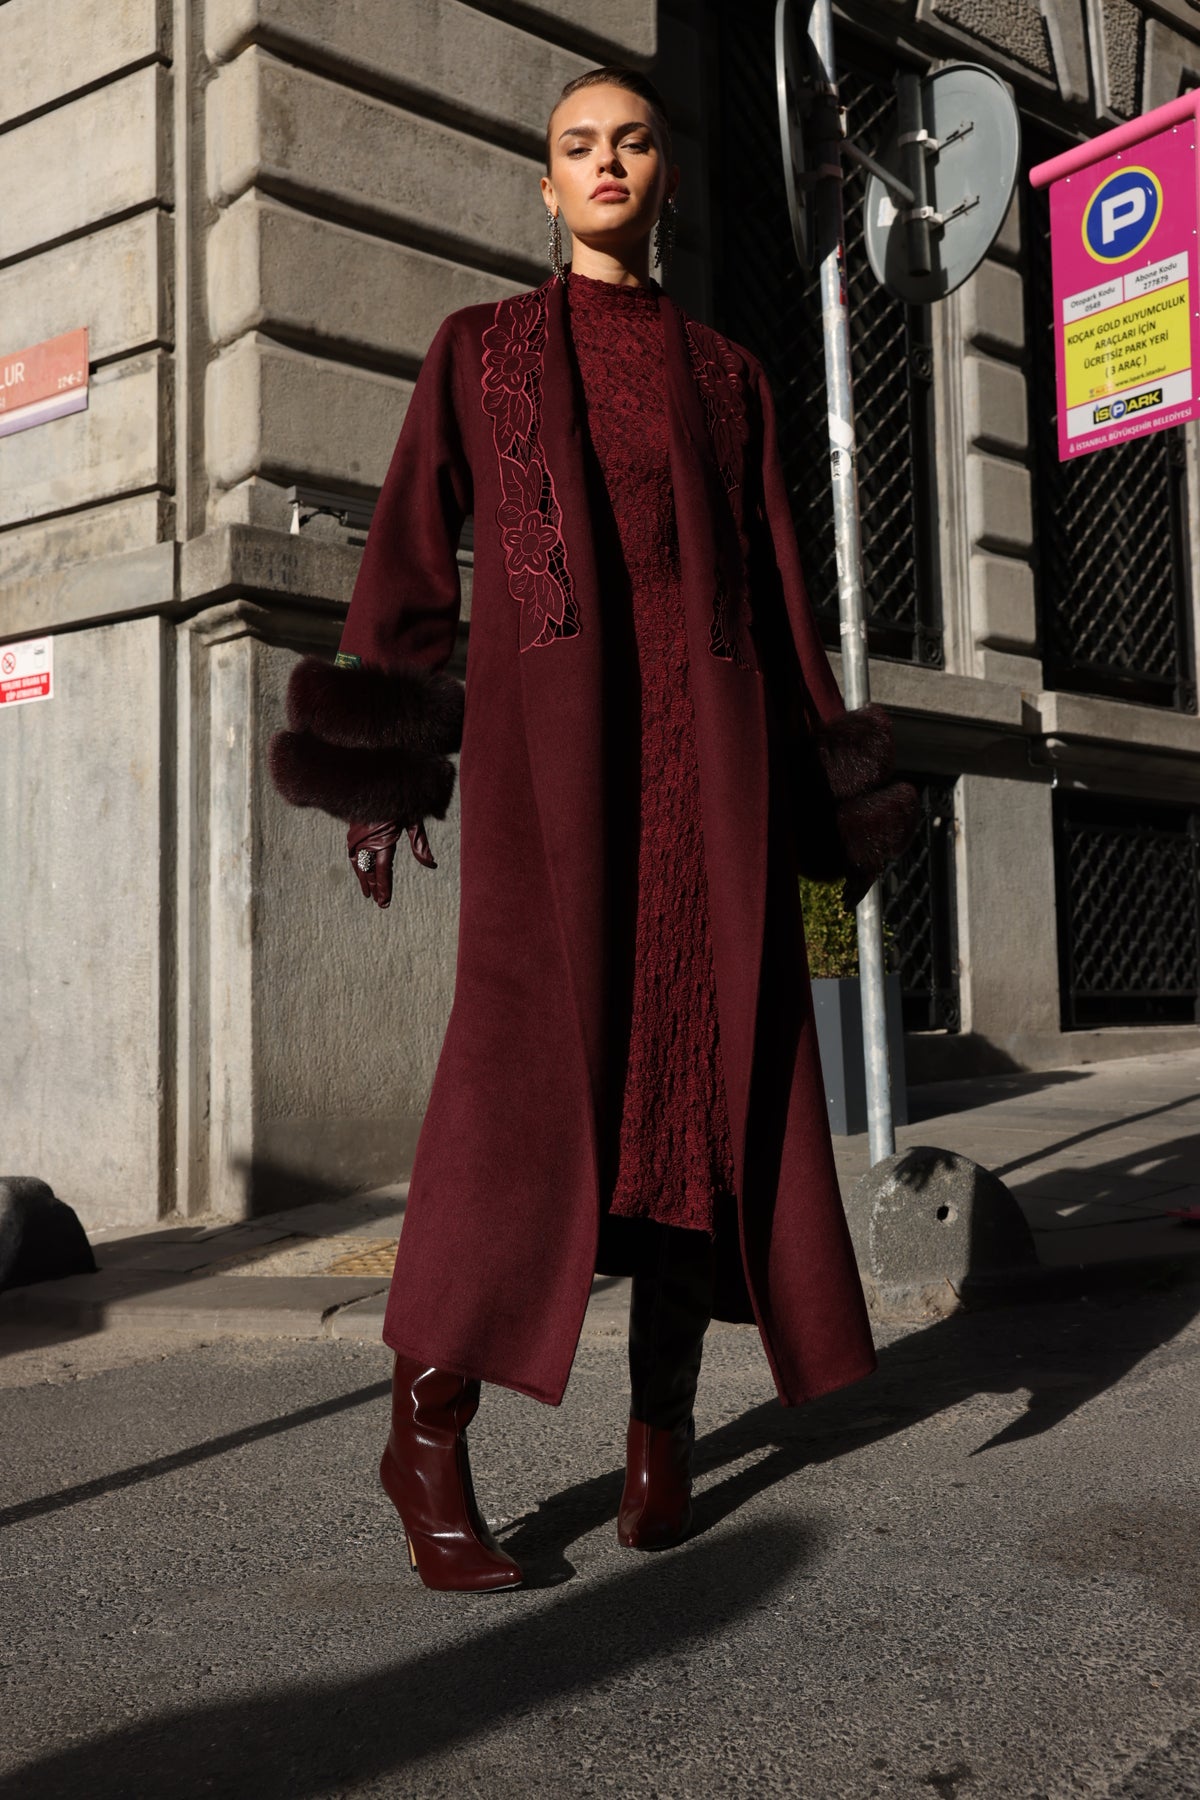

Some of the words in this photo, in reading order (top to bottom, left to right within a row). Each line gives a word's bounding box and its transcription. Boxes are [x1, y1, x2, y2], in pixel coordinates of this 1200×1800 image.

[1101, 187, 1146, 245] P
[1135, 270, 1157, 283] Abone
[1159, 262, 1177, 275] Kodu
[1070, 292, 1096, 308] Otopark
[1098, 286, 1115, 297] Kodu
[1067, 328, 1095, 346] KOÇAK
[1097, 319, 1120, 335] GOLD
[1122, 294, 1186, 324] KUYUMCULUK
[1094, 328, 1136, 350] ARAÇLARI
[1138, 320, 1157, 334] İÇİN
[1083, 348, 1123, 369] ÜCRETSİZ
[1125, 340, 1147, 355] PARK
[1149, 330, 1169, 346] YERİ
[1076, 435, 1108, 451] İSTANBUL
[1108, 420, 1152, 440] BÜYÜKŞEHİR
[1153, 407, 1193, 427] BELEDİYESİ
